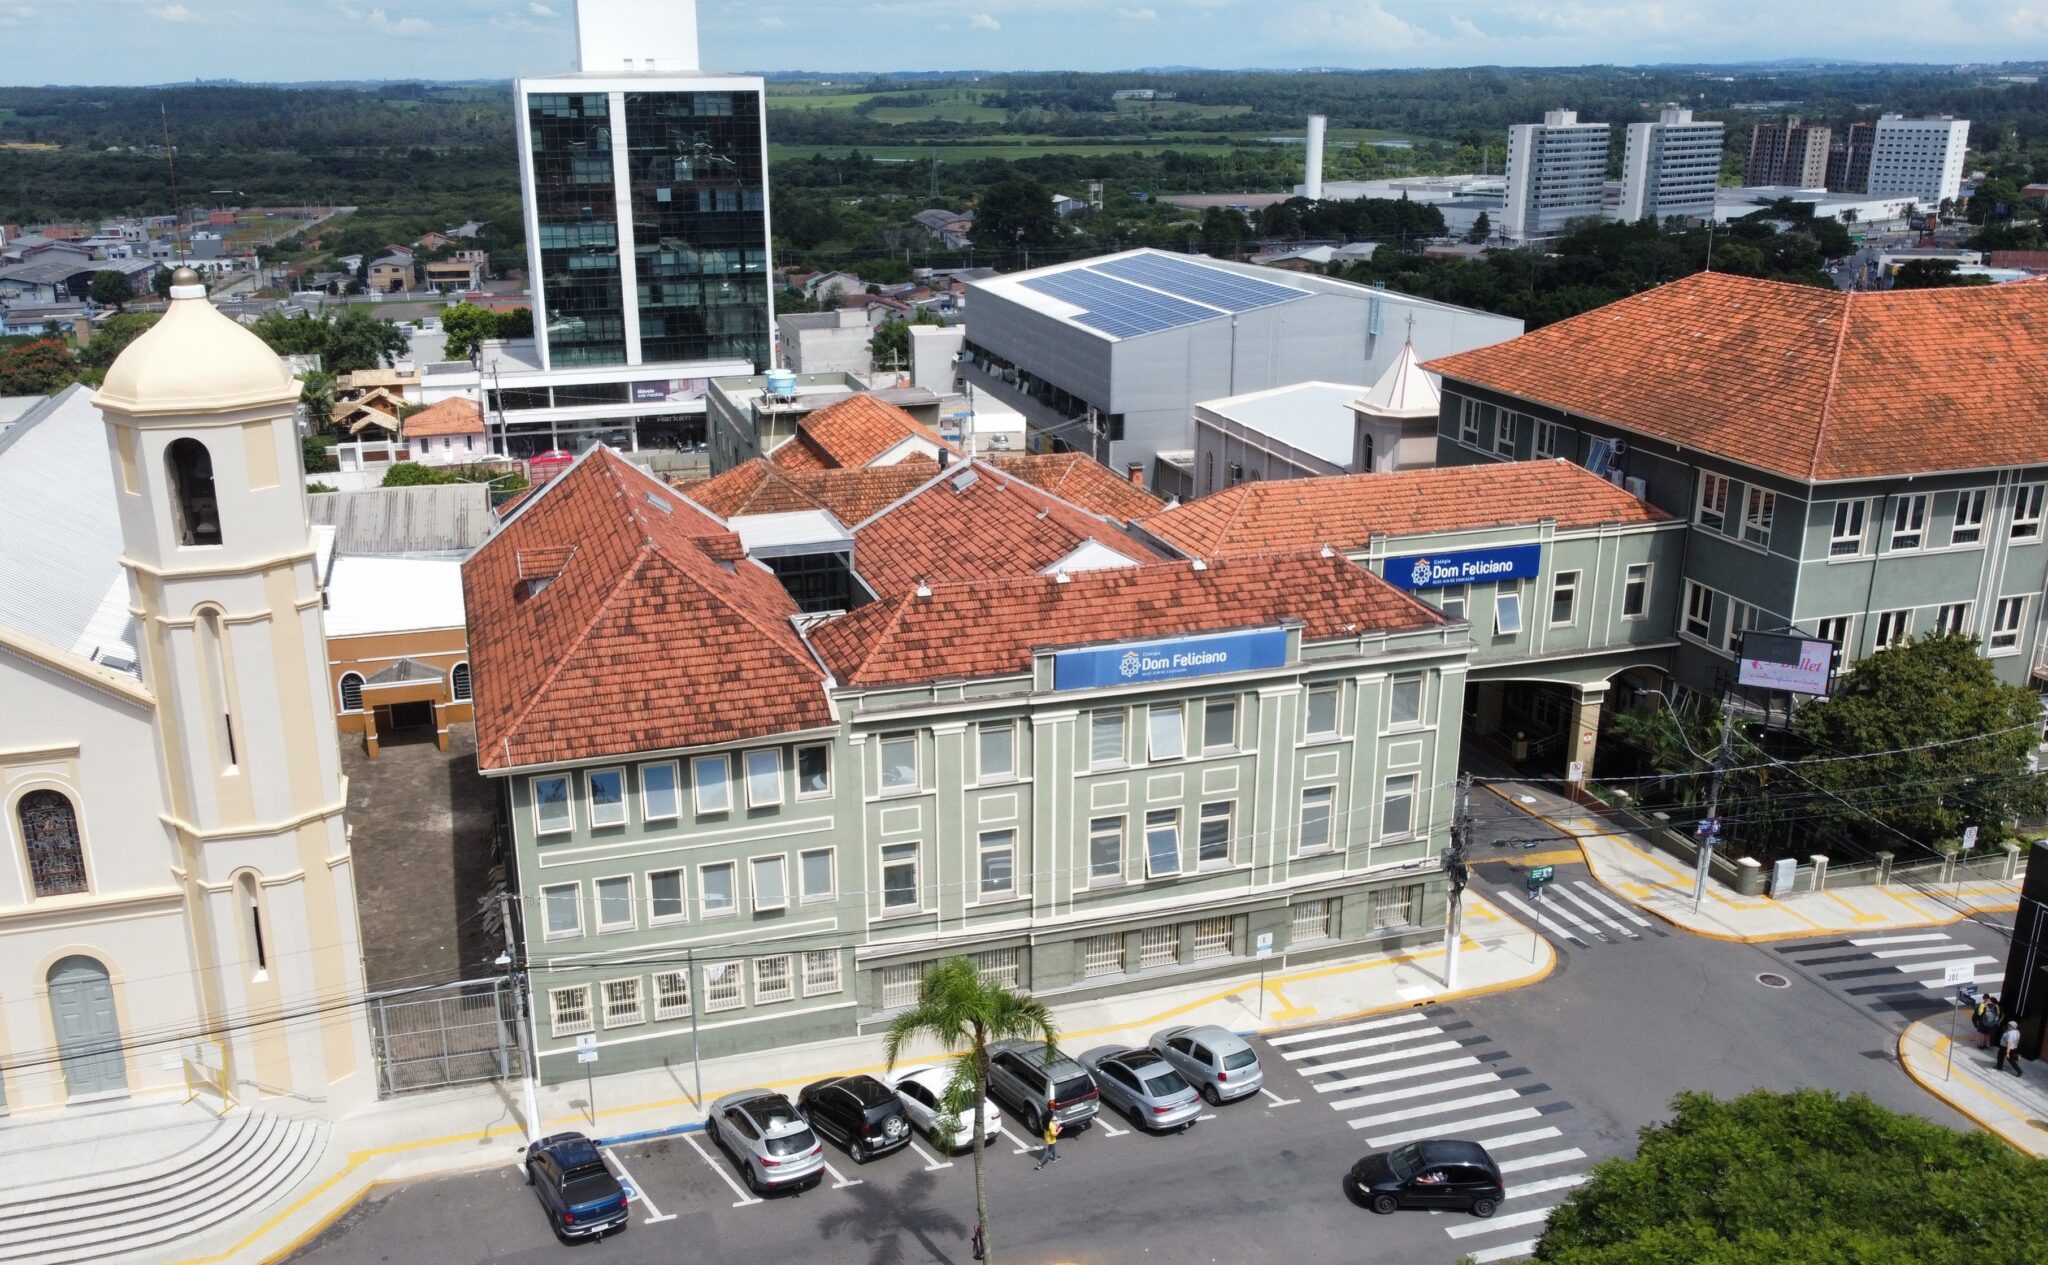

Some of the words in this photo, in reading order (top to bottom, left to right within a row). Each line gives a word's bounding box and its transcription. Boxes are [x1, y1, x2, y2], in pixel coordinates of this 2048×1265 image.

[1433, 565, 1459, 579] Dom
[1462, 560, 1513, 576] Feliciano
[1142, 658, 1169, 671] Dom
[1173, 651, 1227, 668] Feliciano
